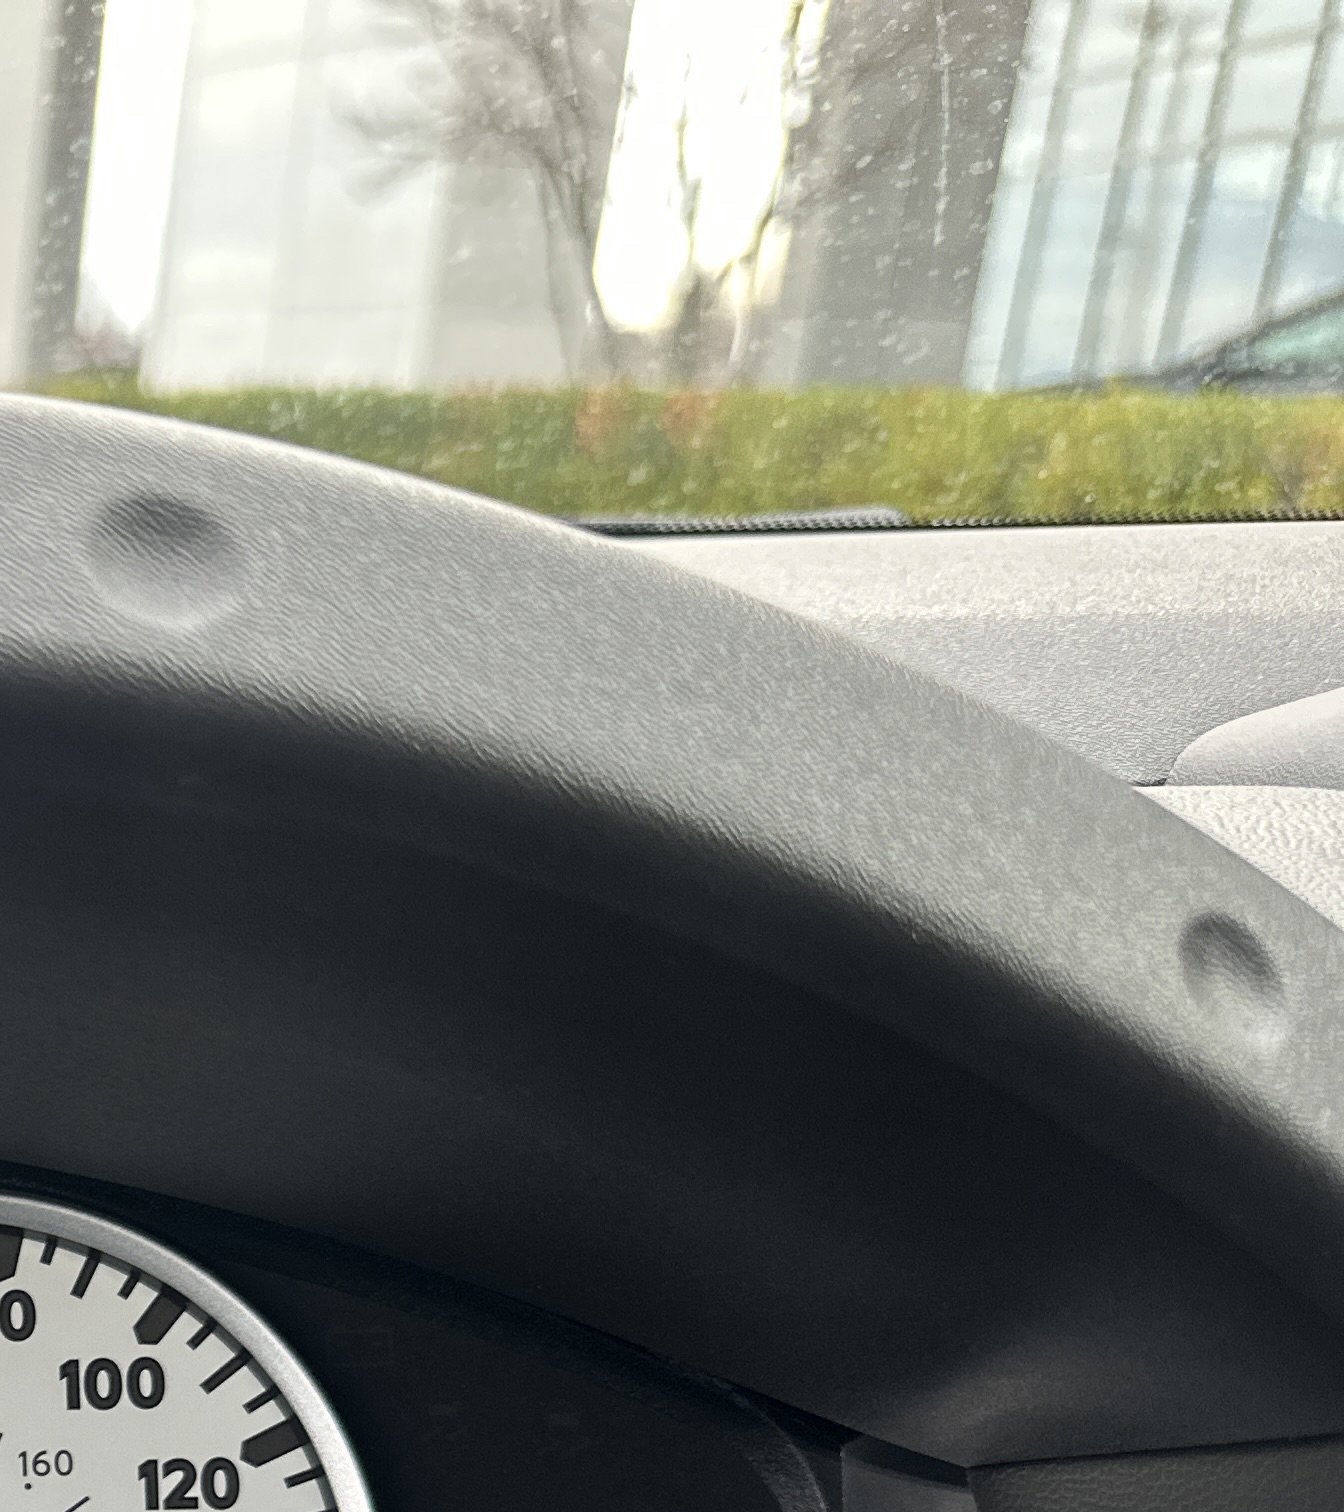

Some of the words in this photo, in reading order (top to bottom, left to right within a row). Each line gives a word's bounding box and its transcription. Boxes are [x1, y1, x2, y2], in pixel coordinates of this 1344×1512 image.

[59, 1356, 166, 1411] 100
[18, 1449, 74, 1477] 160
[137, 1458, 240, 1511] 120
